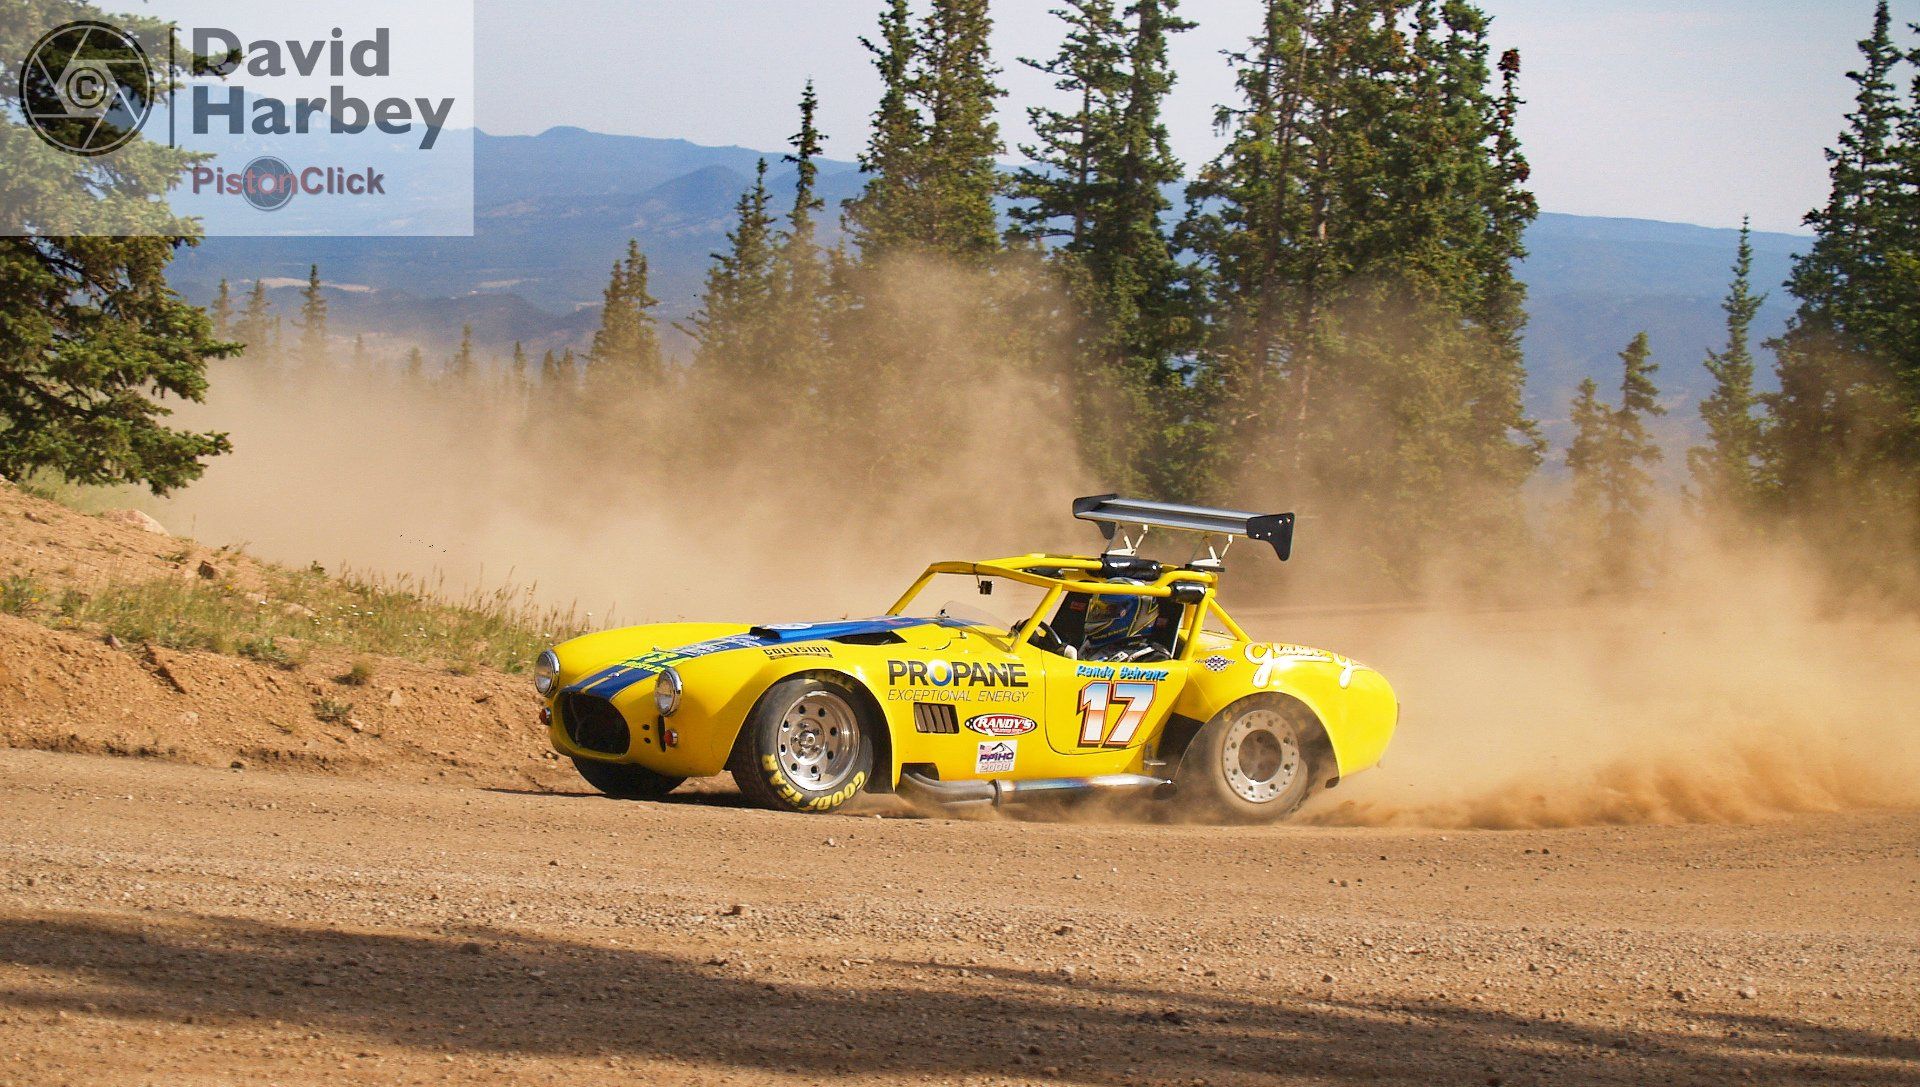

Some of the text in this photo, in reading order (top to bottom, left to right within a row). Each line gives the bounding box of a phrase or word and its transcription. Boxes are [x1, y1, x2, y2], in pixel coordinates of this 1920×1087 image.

[762, 646, 831, 656] COLLISION
[887, 659, 1029, 688] PROPANE
[1076, 665, 1115, 680] Randy
[887, 689, 1029, 703] EXCEPTIONAL ENERGY
[1076, 680, 1157, 748] 17
[978, 717, 1033, 730] RANDY'S
